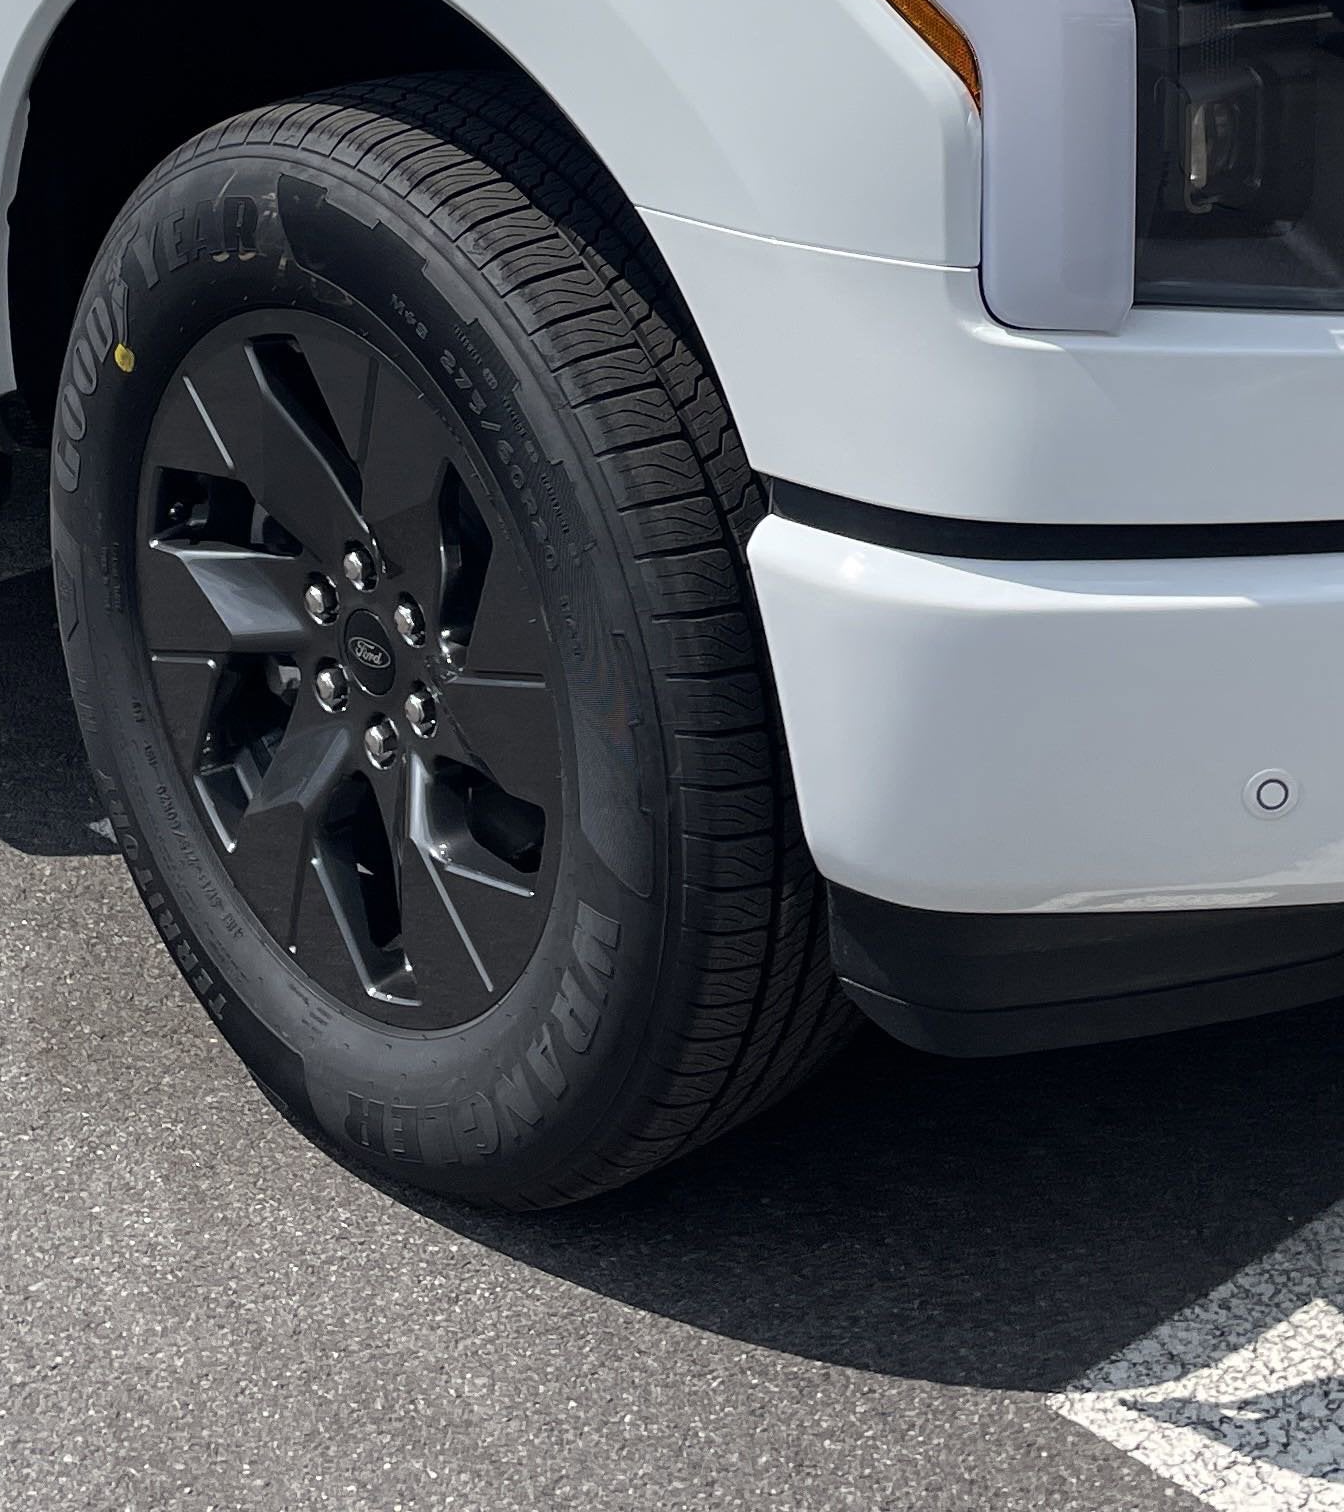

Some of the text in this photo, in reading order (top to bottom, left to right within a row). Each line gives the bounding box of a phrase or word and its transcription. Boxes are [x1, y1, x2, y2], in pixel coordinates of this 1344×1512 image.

[56, 194, 259, 492] GOODYEAR
[94, 770, 227, 1020] TERRITORY
[344, 899, 621, 1165] WRANGLER
